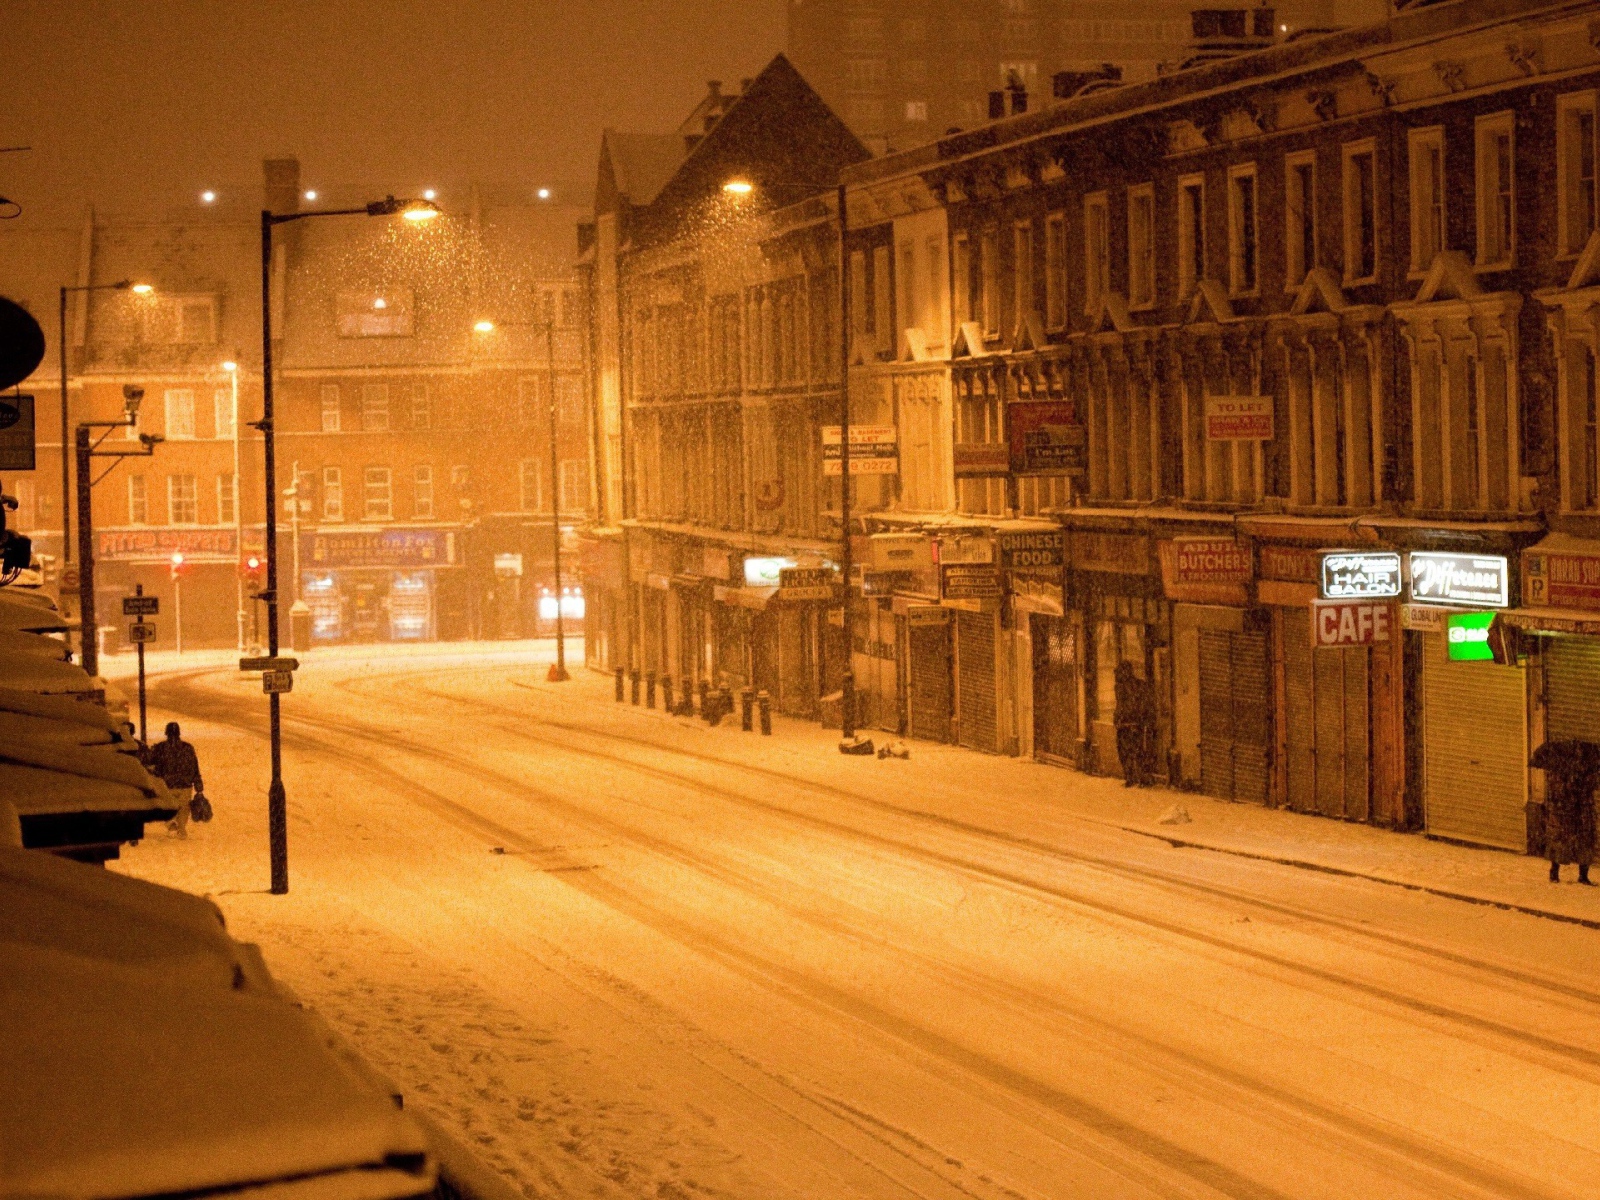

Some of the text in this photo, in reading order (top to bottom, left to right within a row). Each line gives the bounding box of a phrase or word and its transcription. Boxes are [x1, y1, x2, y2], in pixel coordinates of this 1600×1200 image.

[1217, 403, 1263, 412] TO LET
[862, 435, 880, 443] LET
[1002, 534, 1062, 550] CHINESE
[1013, 551, 1052, 566] FOOD
[1179, 554, 1250, 570] BUTCHERS
[1334, 572, 1390, 585] HAIR
[1329, 582, 1396, 595] SALON
[1320, 605, 1390, 644] CAFE
